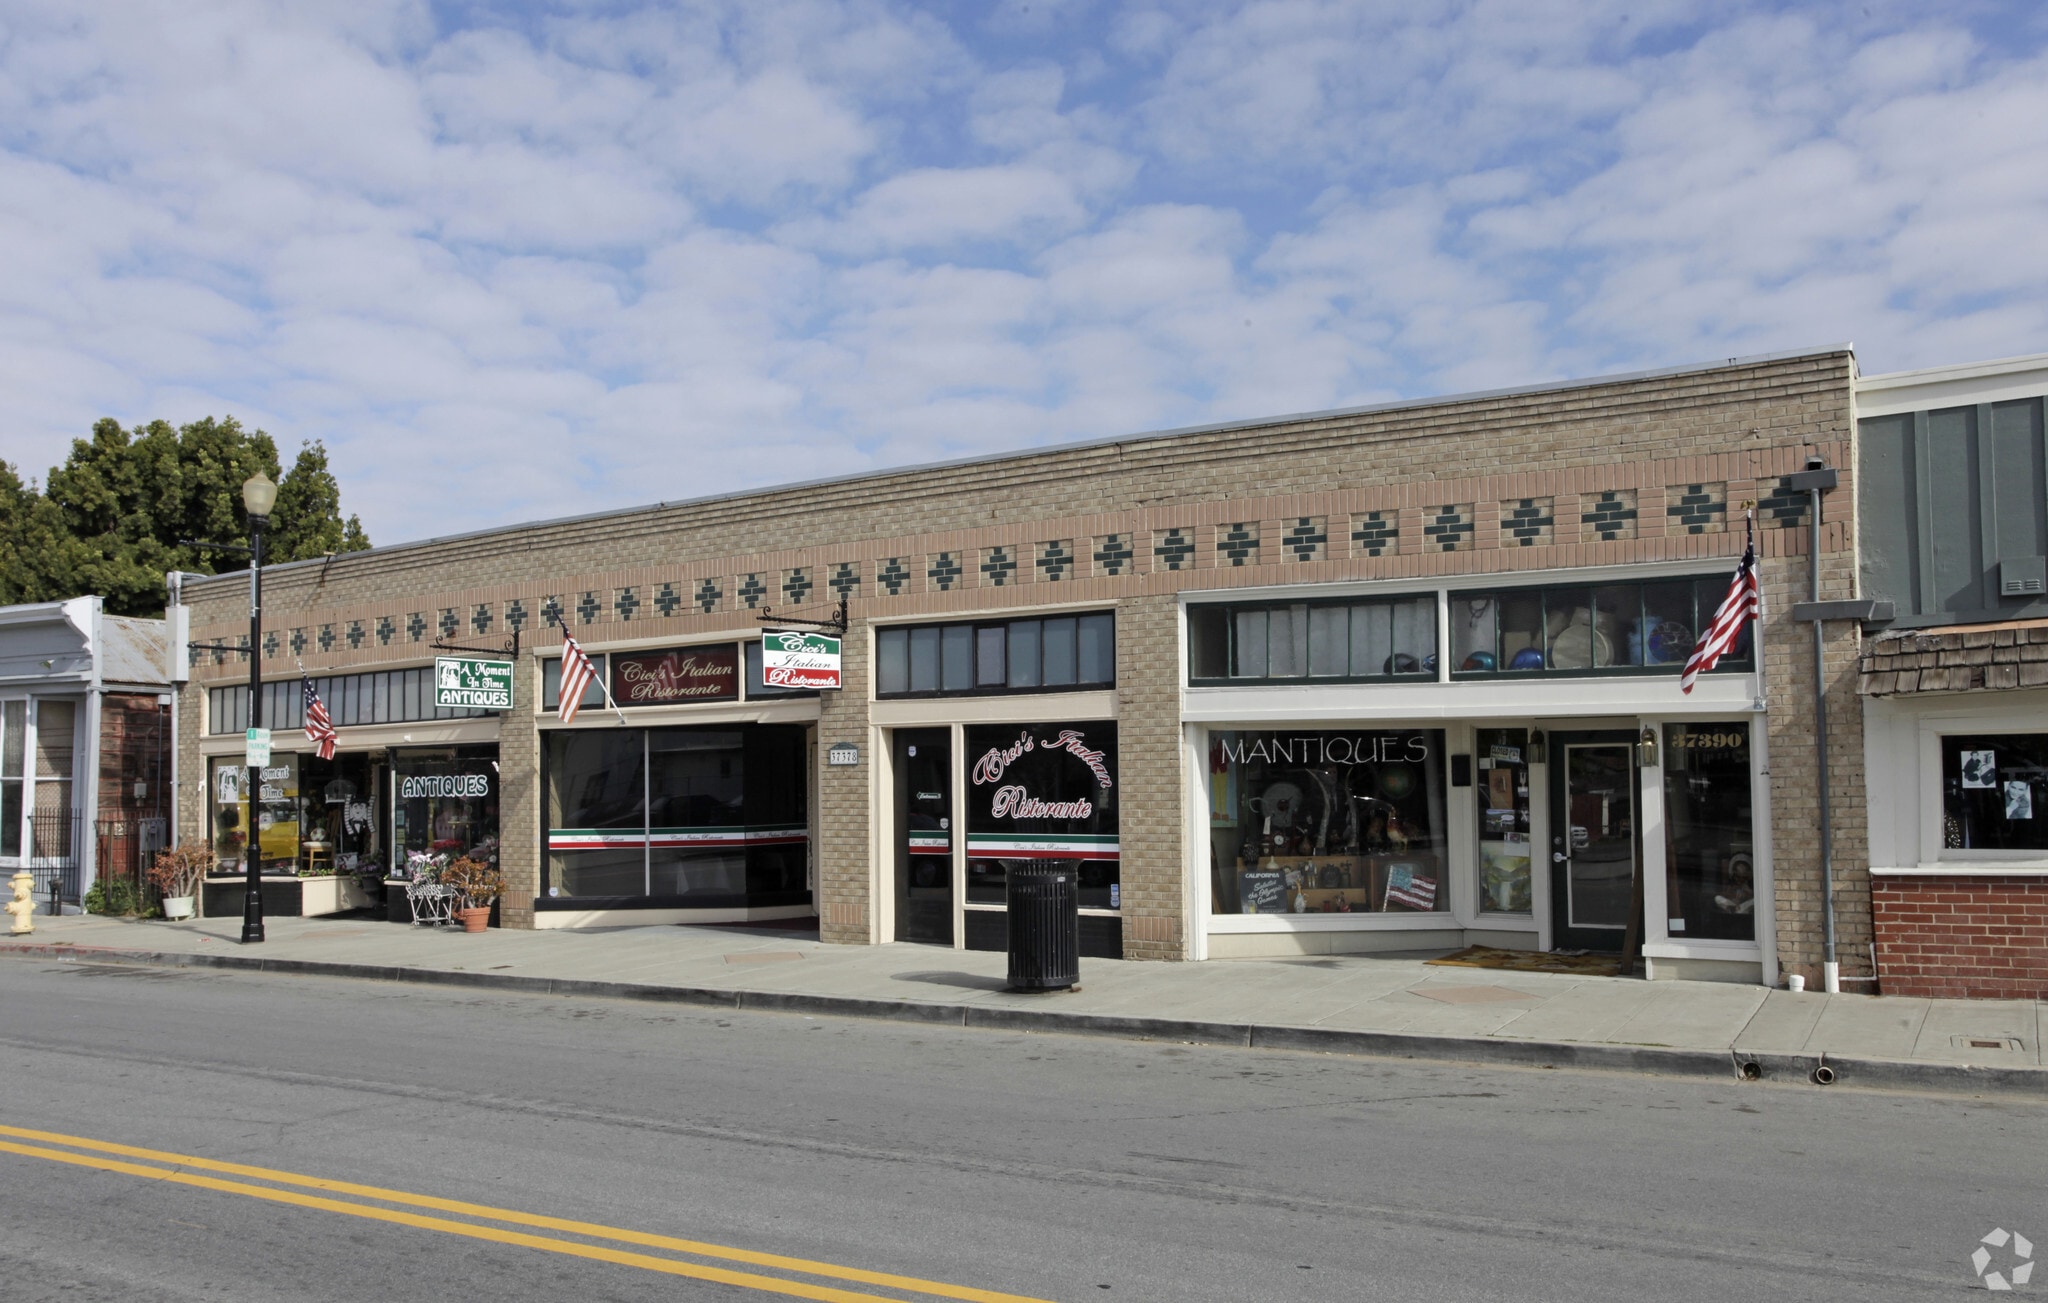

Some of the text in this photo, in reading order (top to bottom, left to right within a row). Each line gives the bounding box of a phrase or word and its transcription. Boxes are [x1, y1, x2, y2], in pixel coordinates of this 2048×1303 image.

[778, 635, 827, 654] Cici's
[460, 662, 511, 677] A Moment
[619, 656, 733, 682] Cici's Italian
[773, 653, 831, 669] Italian
[466, 676, 505, 689] In Time
[768, 668, 837, 686] Ristorante
[440, 689, 509, 706] ANTIQUES
[630, 681, 722, 702] Ristorante
[1671, 733, 1743, 748] 37390
[972, 730, 1113, 788] Cici's Italian
[1221, 736, 1429, 765] MANTIQUES
[259, 784, 283, 800] Time
[401, 775, 489, 798] ANTIQUES
[991, 785, 1093, 819] Ristorante
